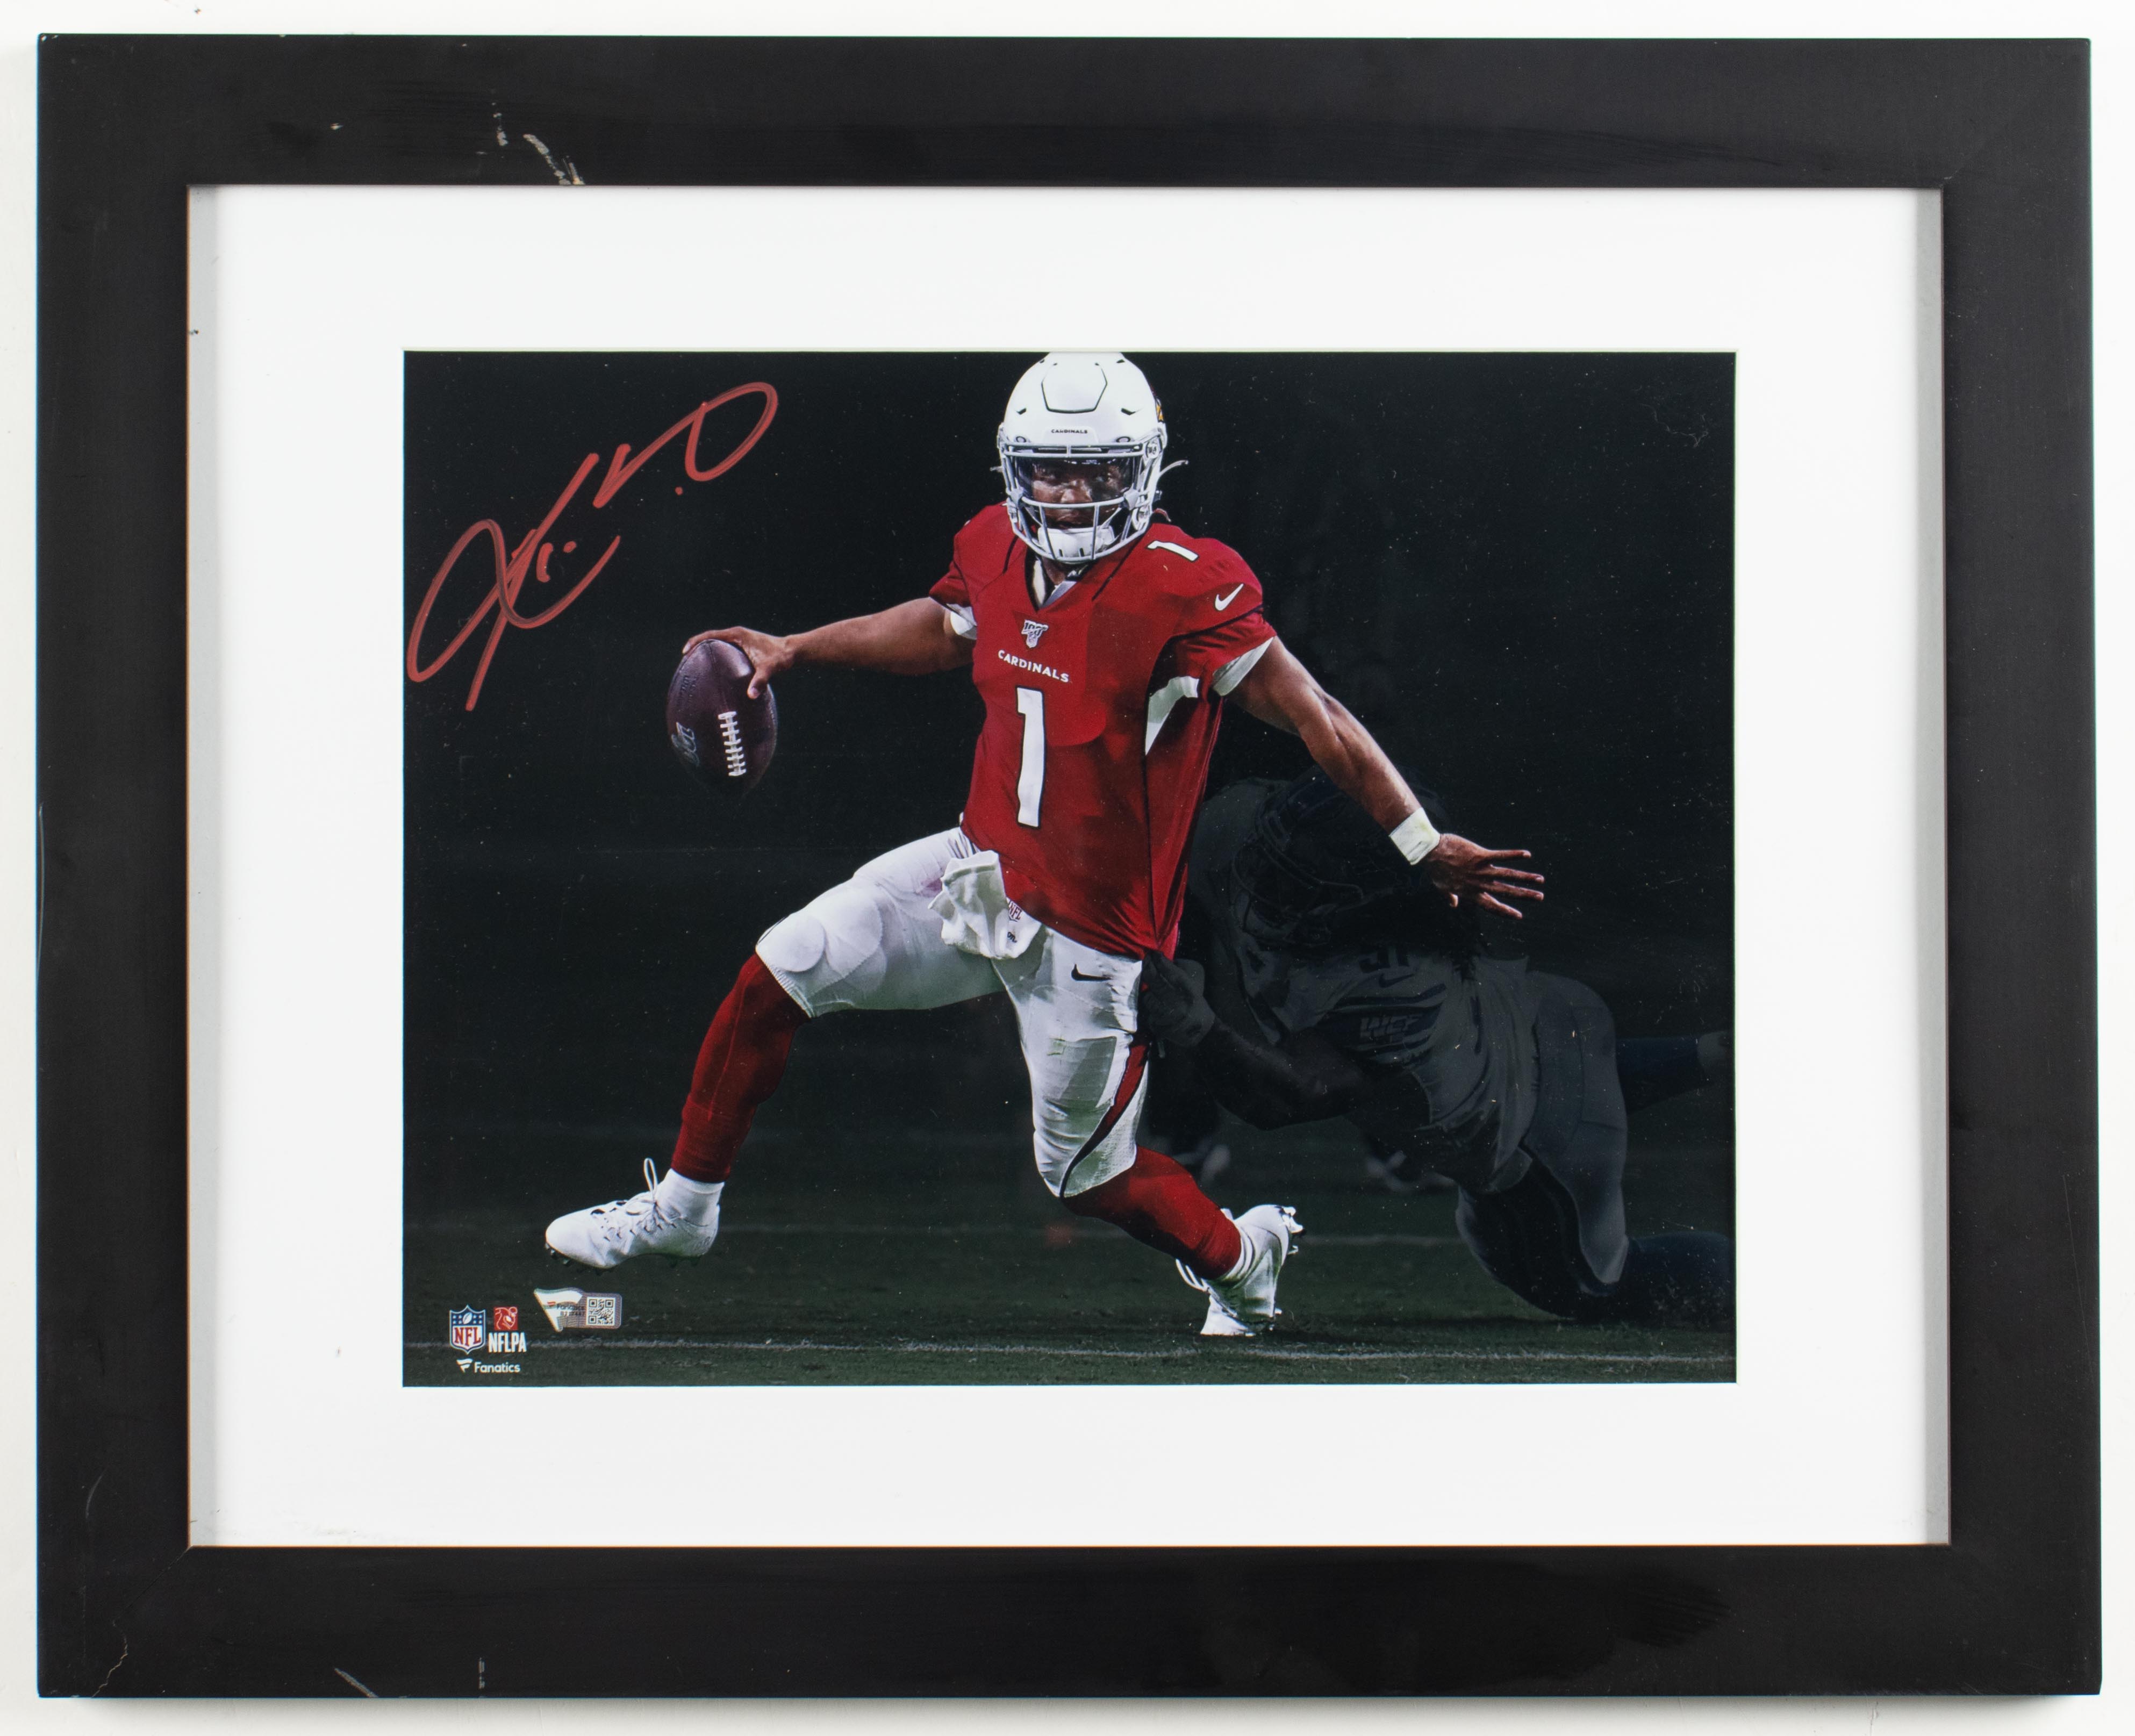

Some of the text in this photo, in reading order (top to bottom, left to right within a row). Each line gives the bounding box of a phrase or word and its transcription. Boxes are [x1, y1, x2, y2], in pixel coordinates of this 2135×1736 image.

[1147, 540, 1199, 562] 1
[998, 649, 1069, 683] CARDINALS
[1016, 686, 1045, 828] 1
[454, 1326, 482, 1347] NFL
[488, 1332, 527, 1353] NFLPA
[474, 1361, 520, 1373] Fanatics
